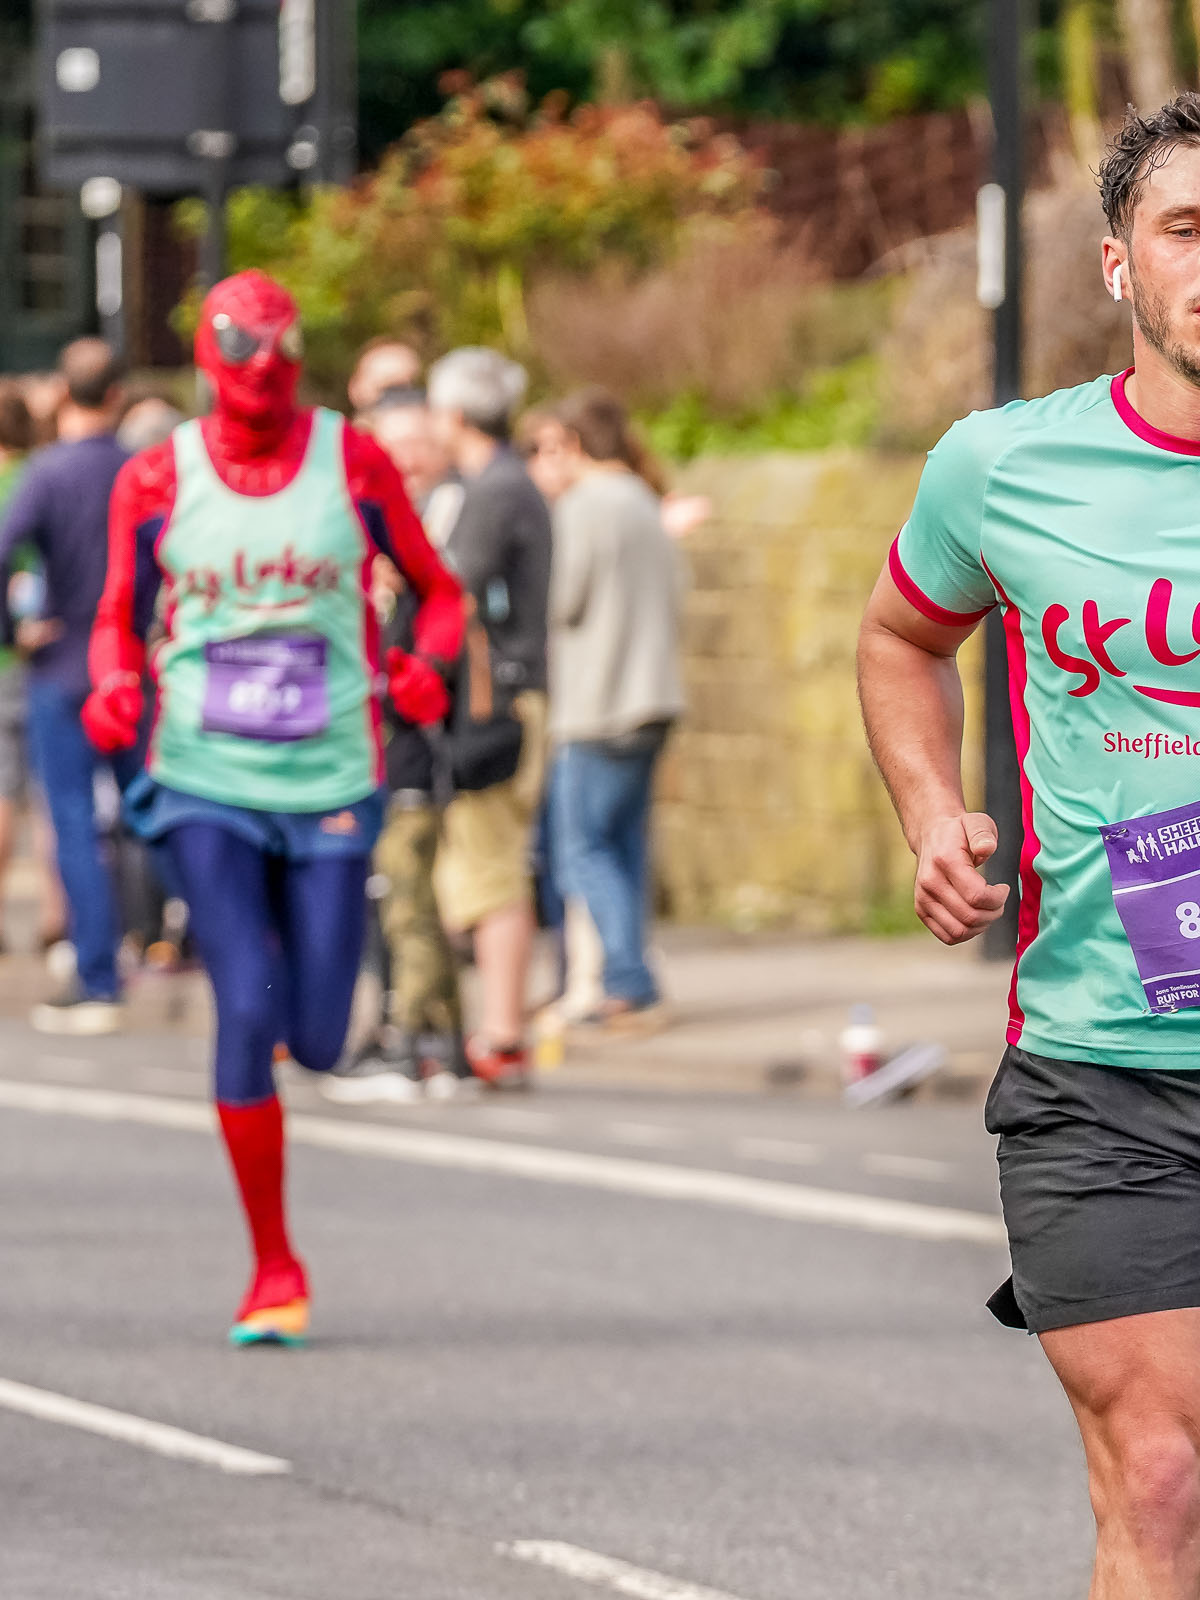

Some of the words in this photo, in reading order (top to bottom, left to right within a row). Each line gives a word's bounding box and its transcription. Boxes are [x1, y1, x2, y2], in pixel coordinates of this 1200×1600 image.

[1042, 599, 1132, 697] St
[1156, 991, 1180, 1006] RUN
[1180, 989, 1200, 1000] FOR
